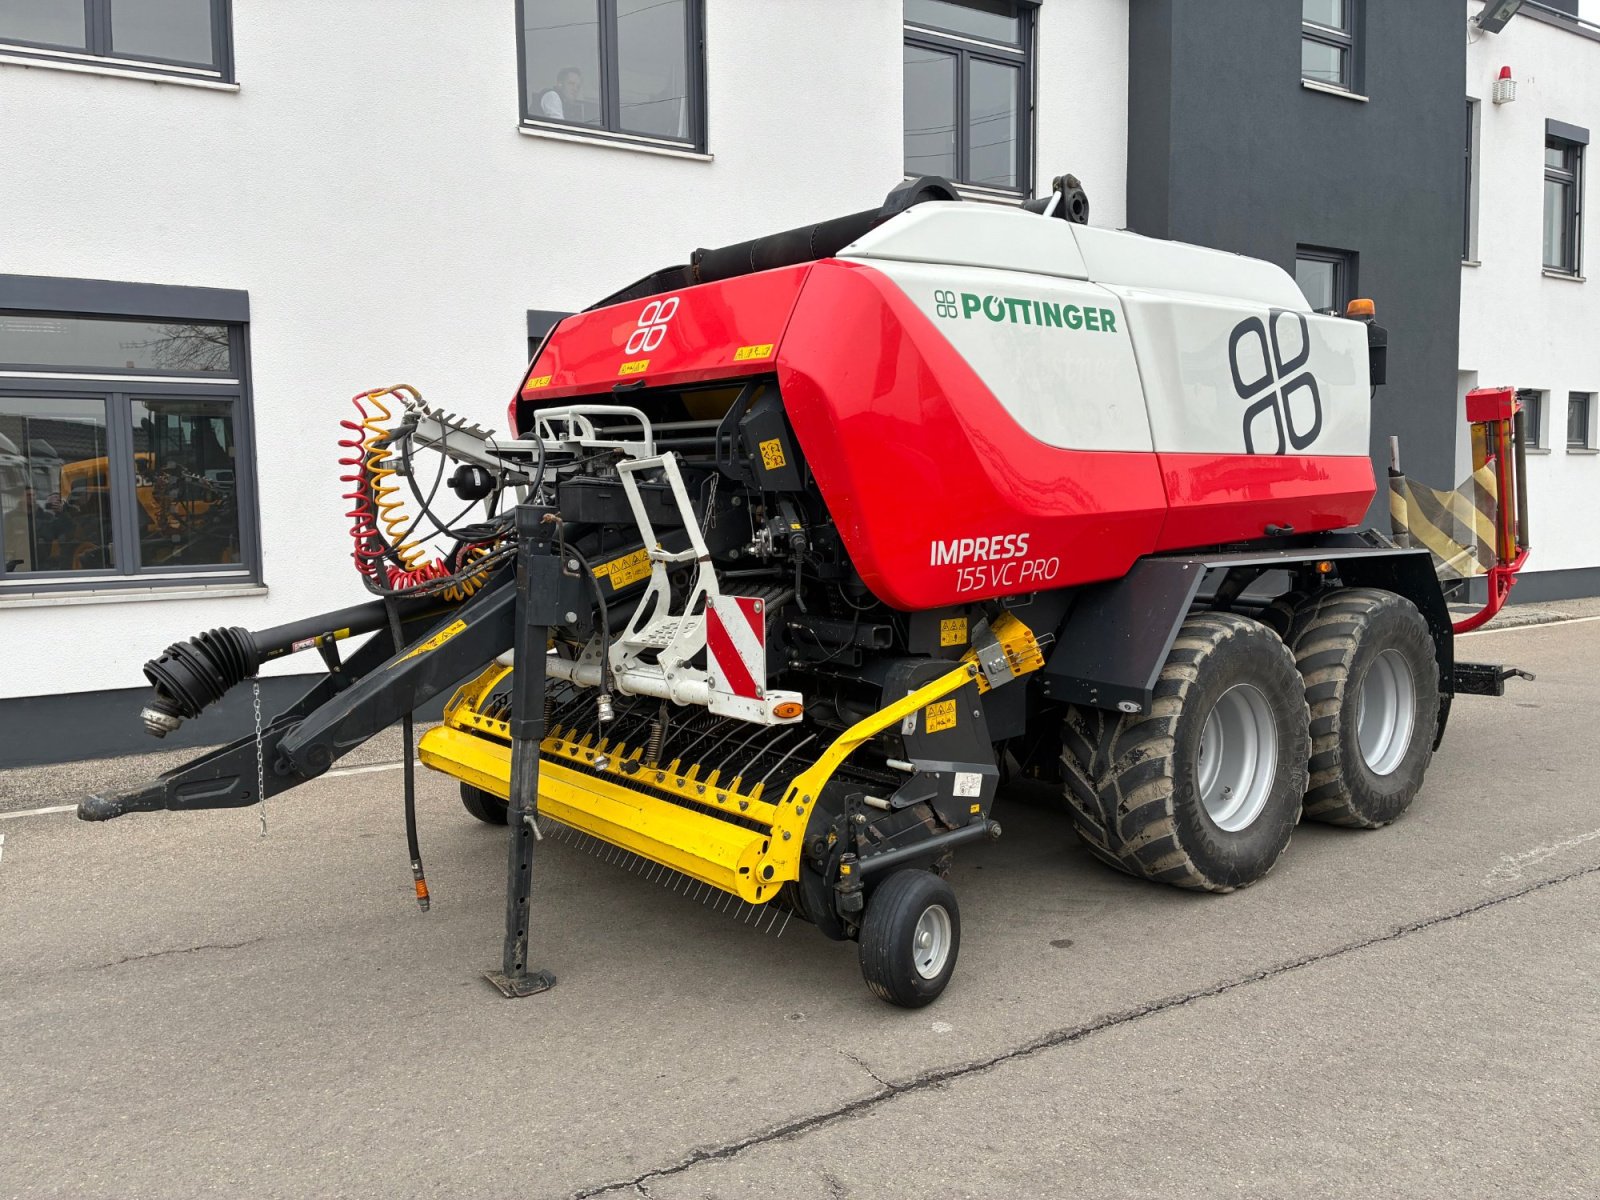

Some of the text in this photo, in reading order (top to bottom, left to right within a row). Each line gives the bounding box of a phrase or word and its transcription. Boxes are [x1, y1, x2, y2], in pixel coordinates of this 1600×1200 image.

[961, 293, 1117, 332] PÖTTINGER
[930, 533, 1030, 566] IMPRESS
[956, 557, 1060, 592] 155 VC PRO
